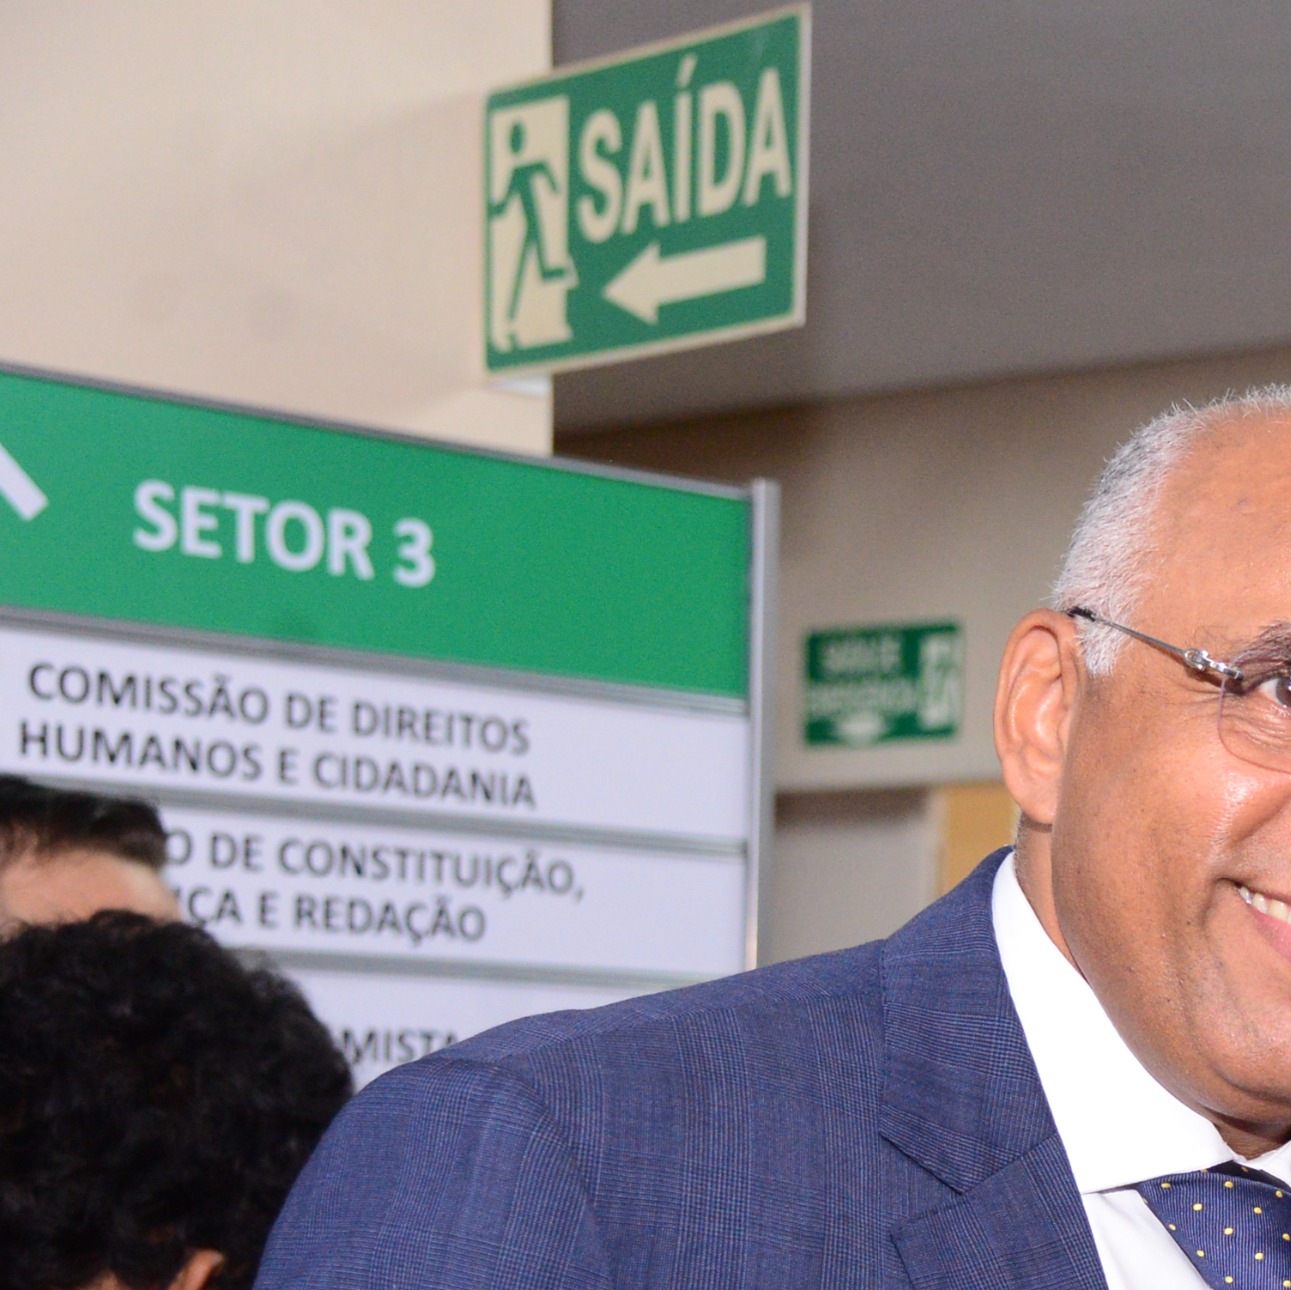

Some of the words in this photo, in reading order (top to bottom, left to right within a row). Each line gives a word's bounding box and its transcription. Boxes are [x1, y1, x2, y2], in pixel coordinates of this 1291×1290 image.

[577, 54, 792, 243] SAÍDA
[134, 479, 375, 580] SETOR
[393, 519, 436, 588] 3
[28, 661, 269, 725] COMISSÃO
[285, 693, 338, 733] DE
[352, 701, 531, 757] DIREITOS
[19, 720, 263, 783] HUMANOS
[278, 748, 299, 785] E
[312, 751, 537, 810] CIDADANIA
[210, 831, 264, 872] DE
[278, 836, 585, 901] CONSTITUIÇÃO,
[259, 890, 280, 929] E
[295, 892, 487, 947] REDAÇÃO
